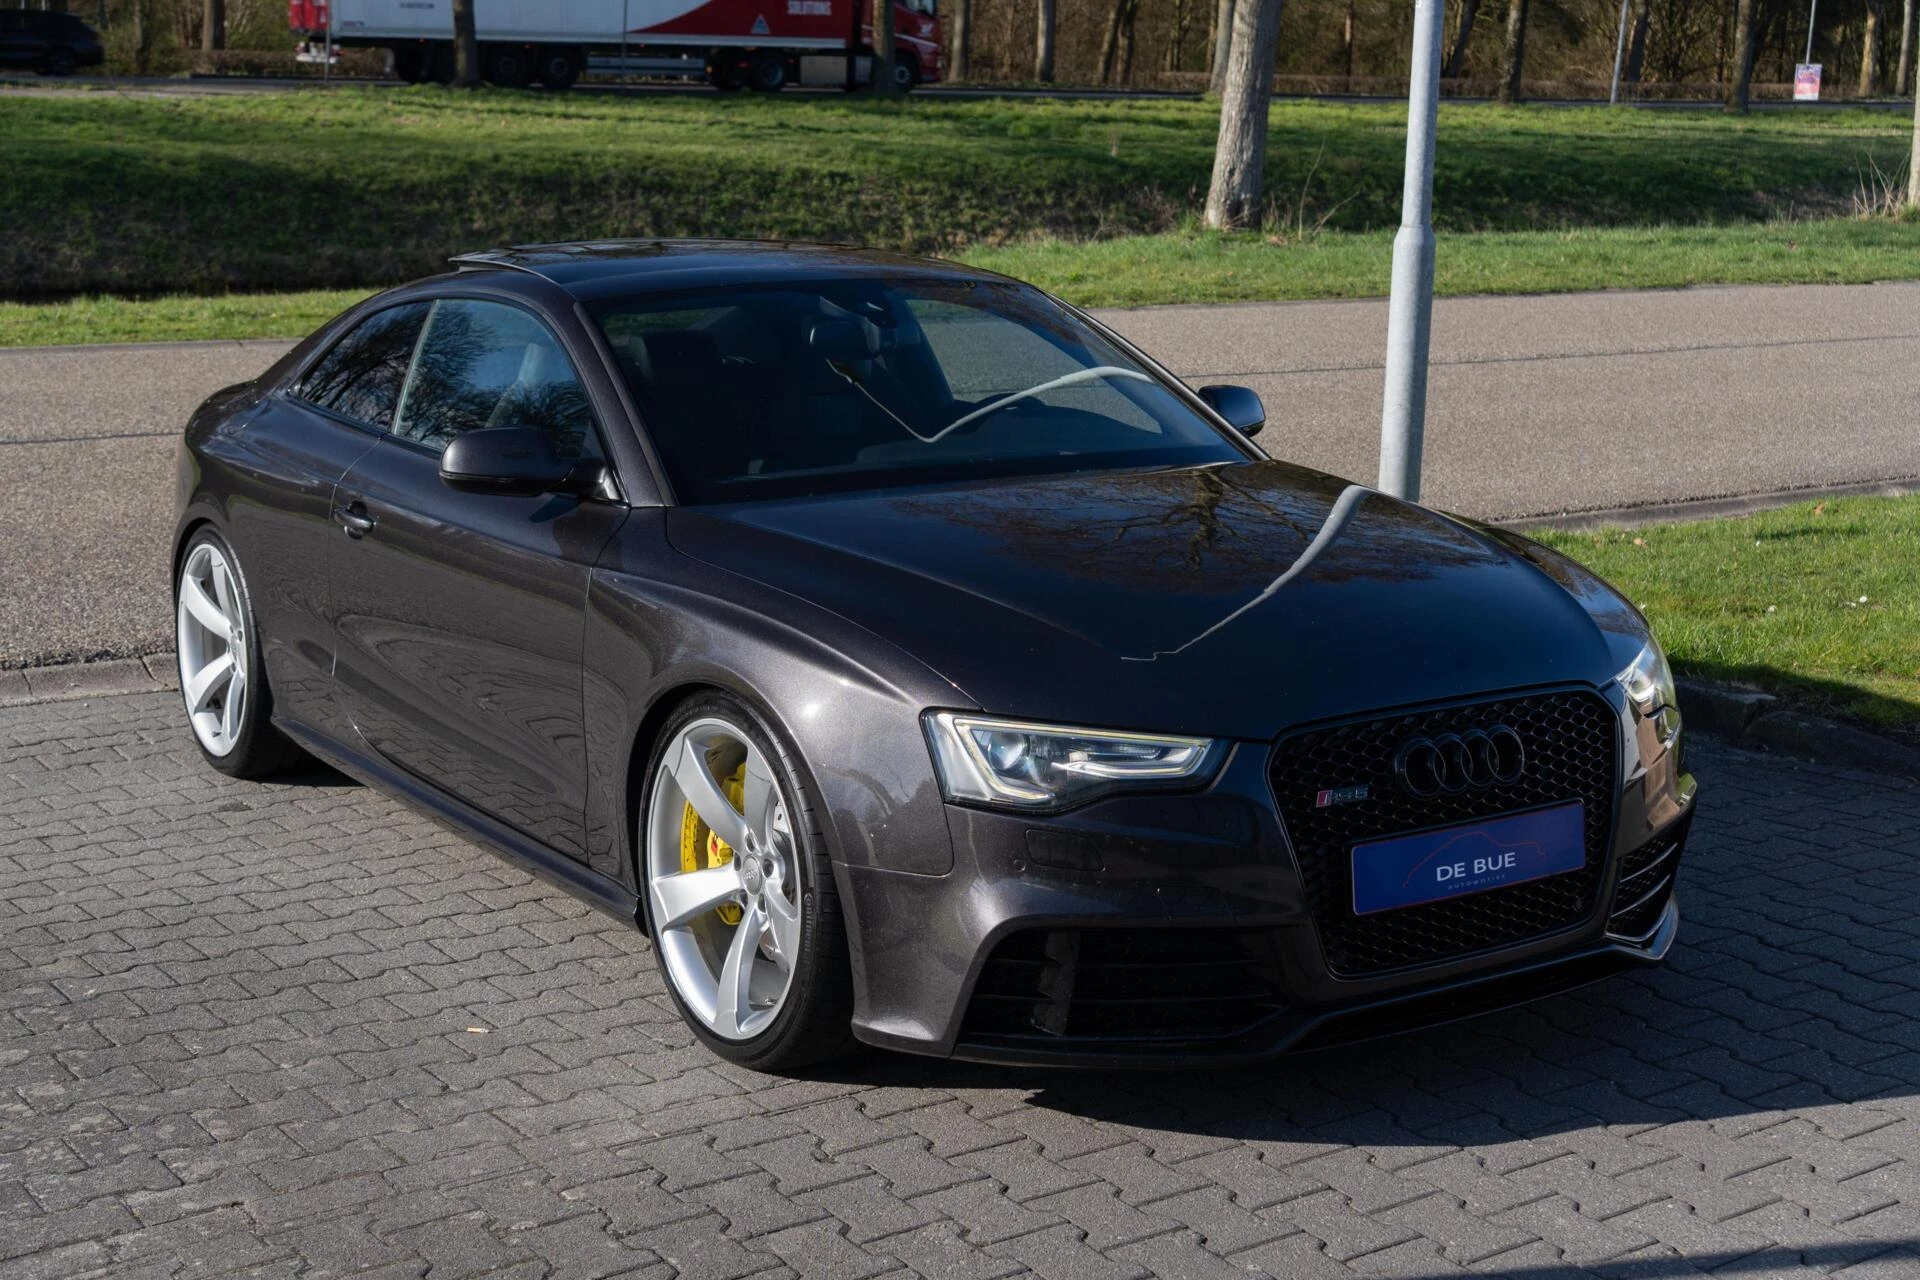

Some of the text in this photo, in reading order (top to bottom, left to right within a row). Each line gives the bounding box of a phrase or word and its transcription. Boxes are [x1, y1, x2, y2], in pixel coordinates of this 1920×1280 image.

[787, 1, 832, 15] SOLUTIONS
[1436, 851, 1516, 882] DE BUE
